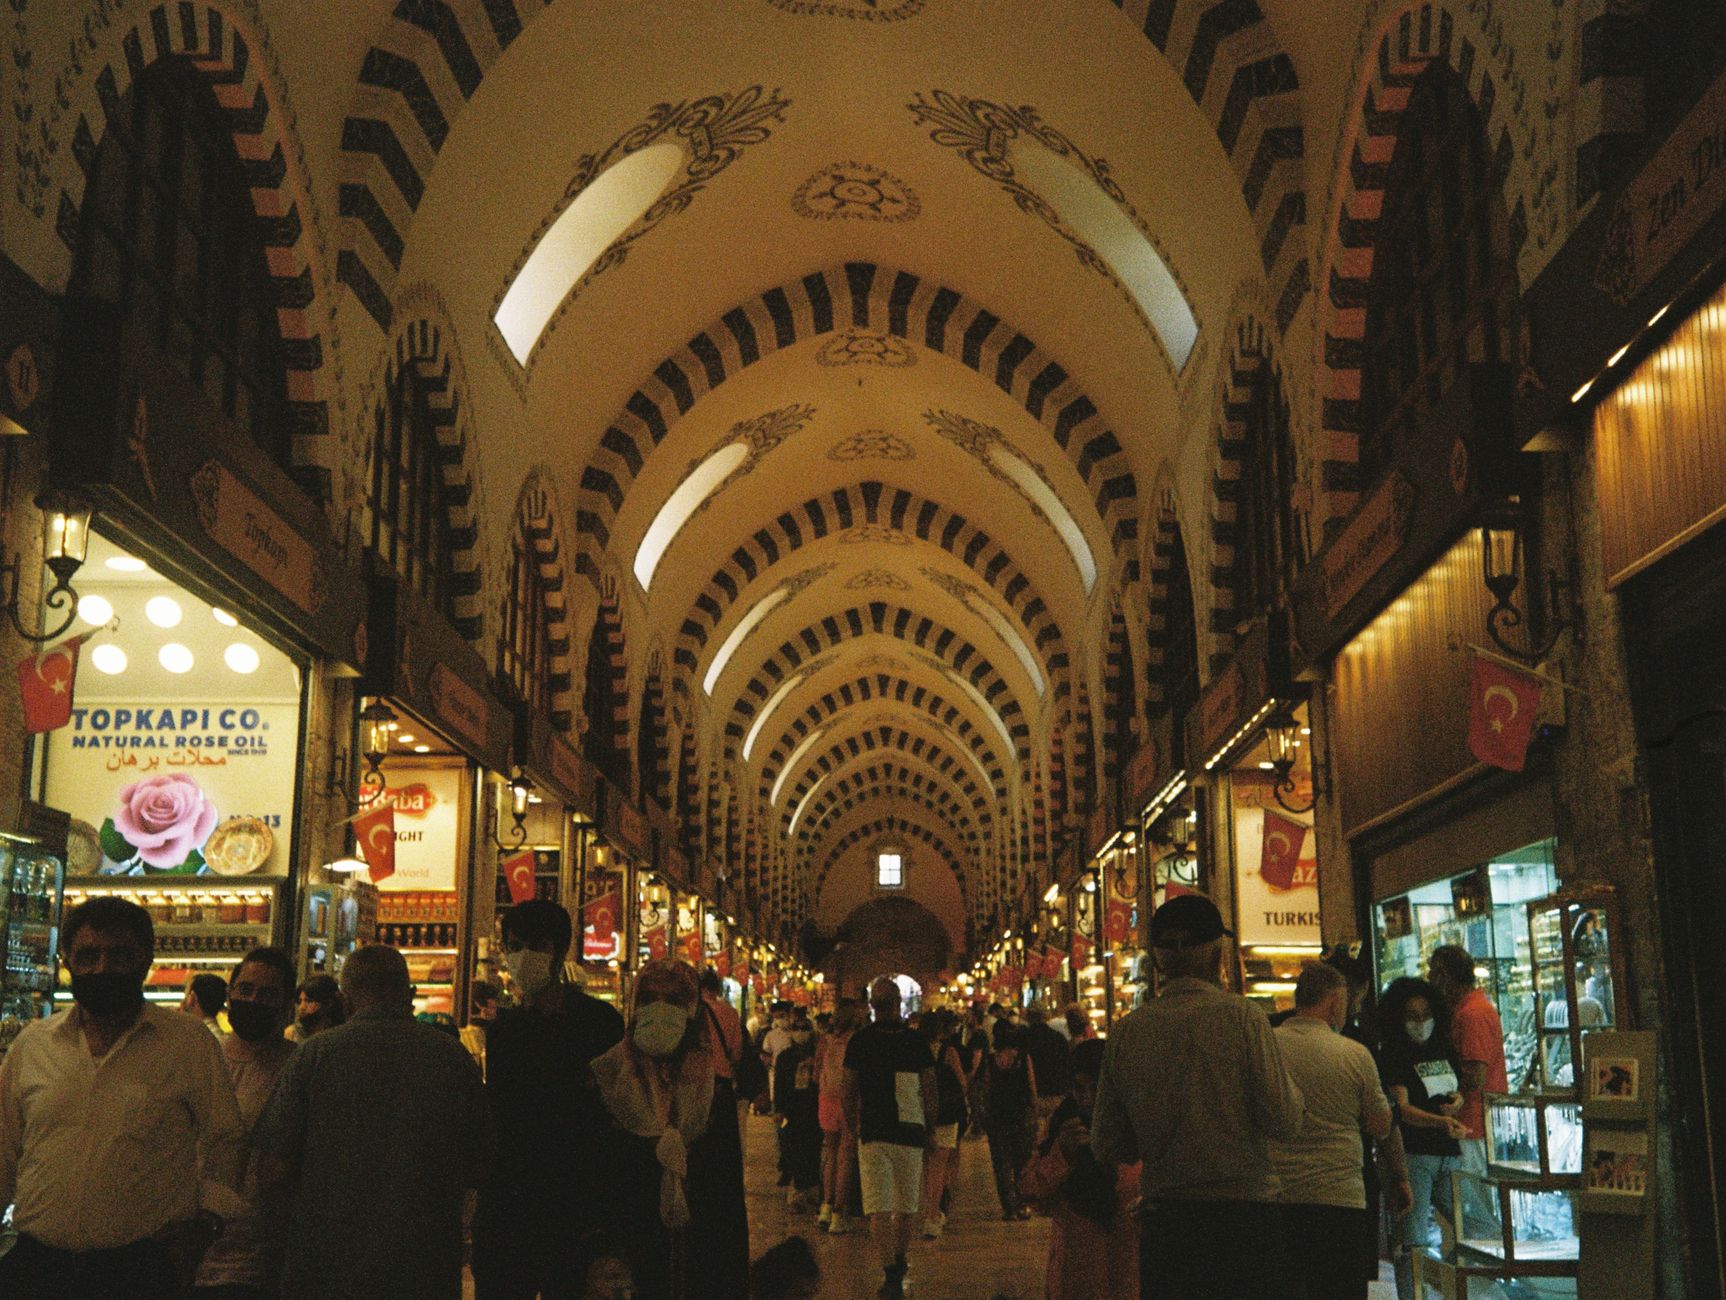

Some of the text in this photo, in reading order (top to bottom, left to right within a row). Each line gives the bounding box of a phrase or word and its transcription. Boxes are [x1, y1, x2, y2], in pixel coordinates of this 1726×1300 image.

[72, 708, 211, 731] TOPKAPI
[72, 735, 268, 748] NATURAL ROSE OIL
